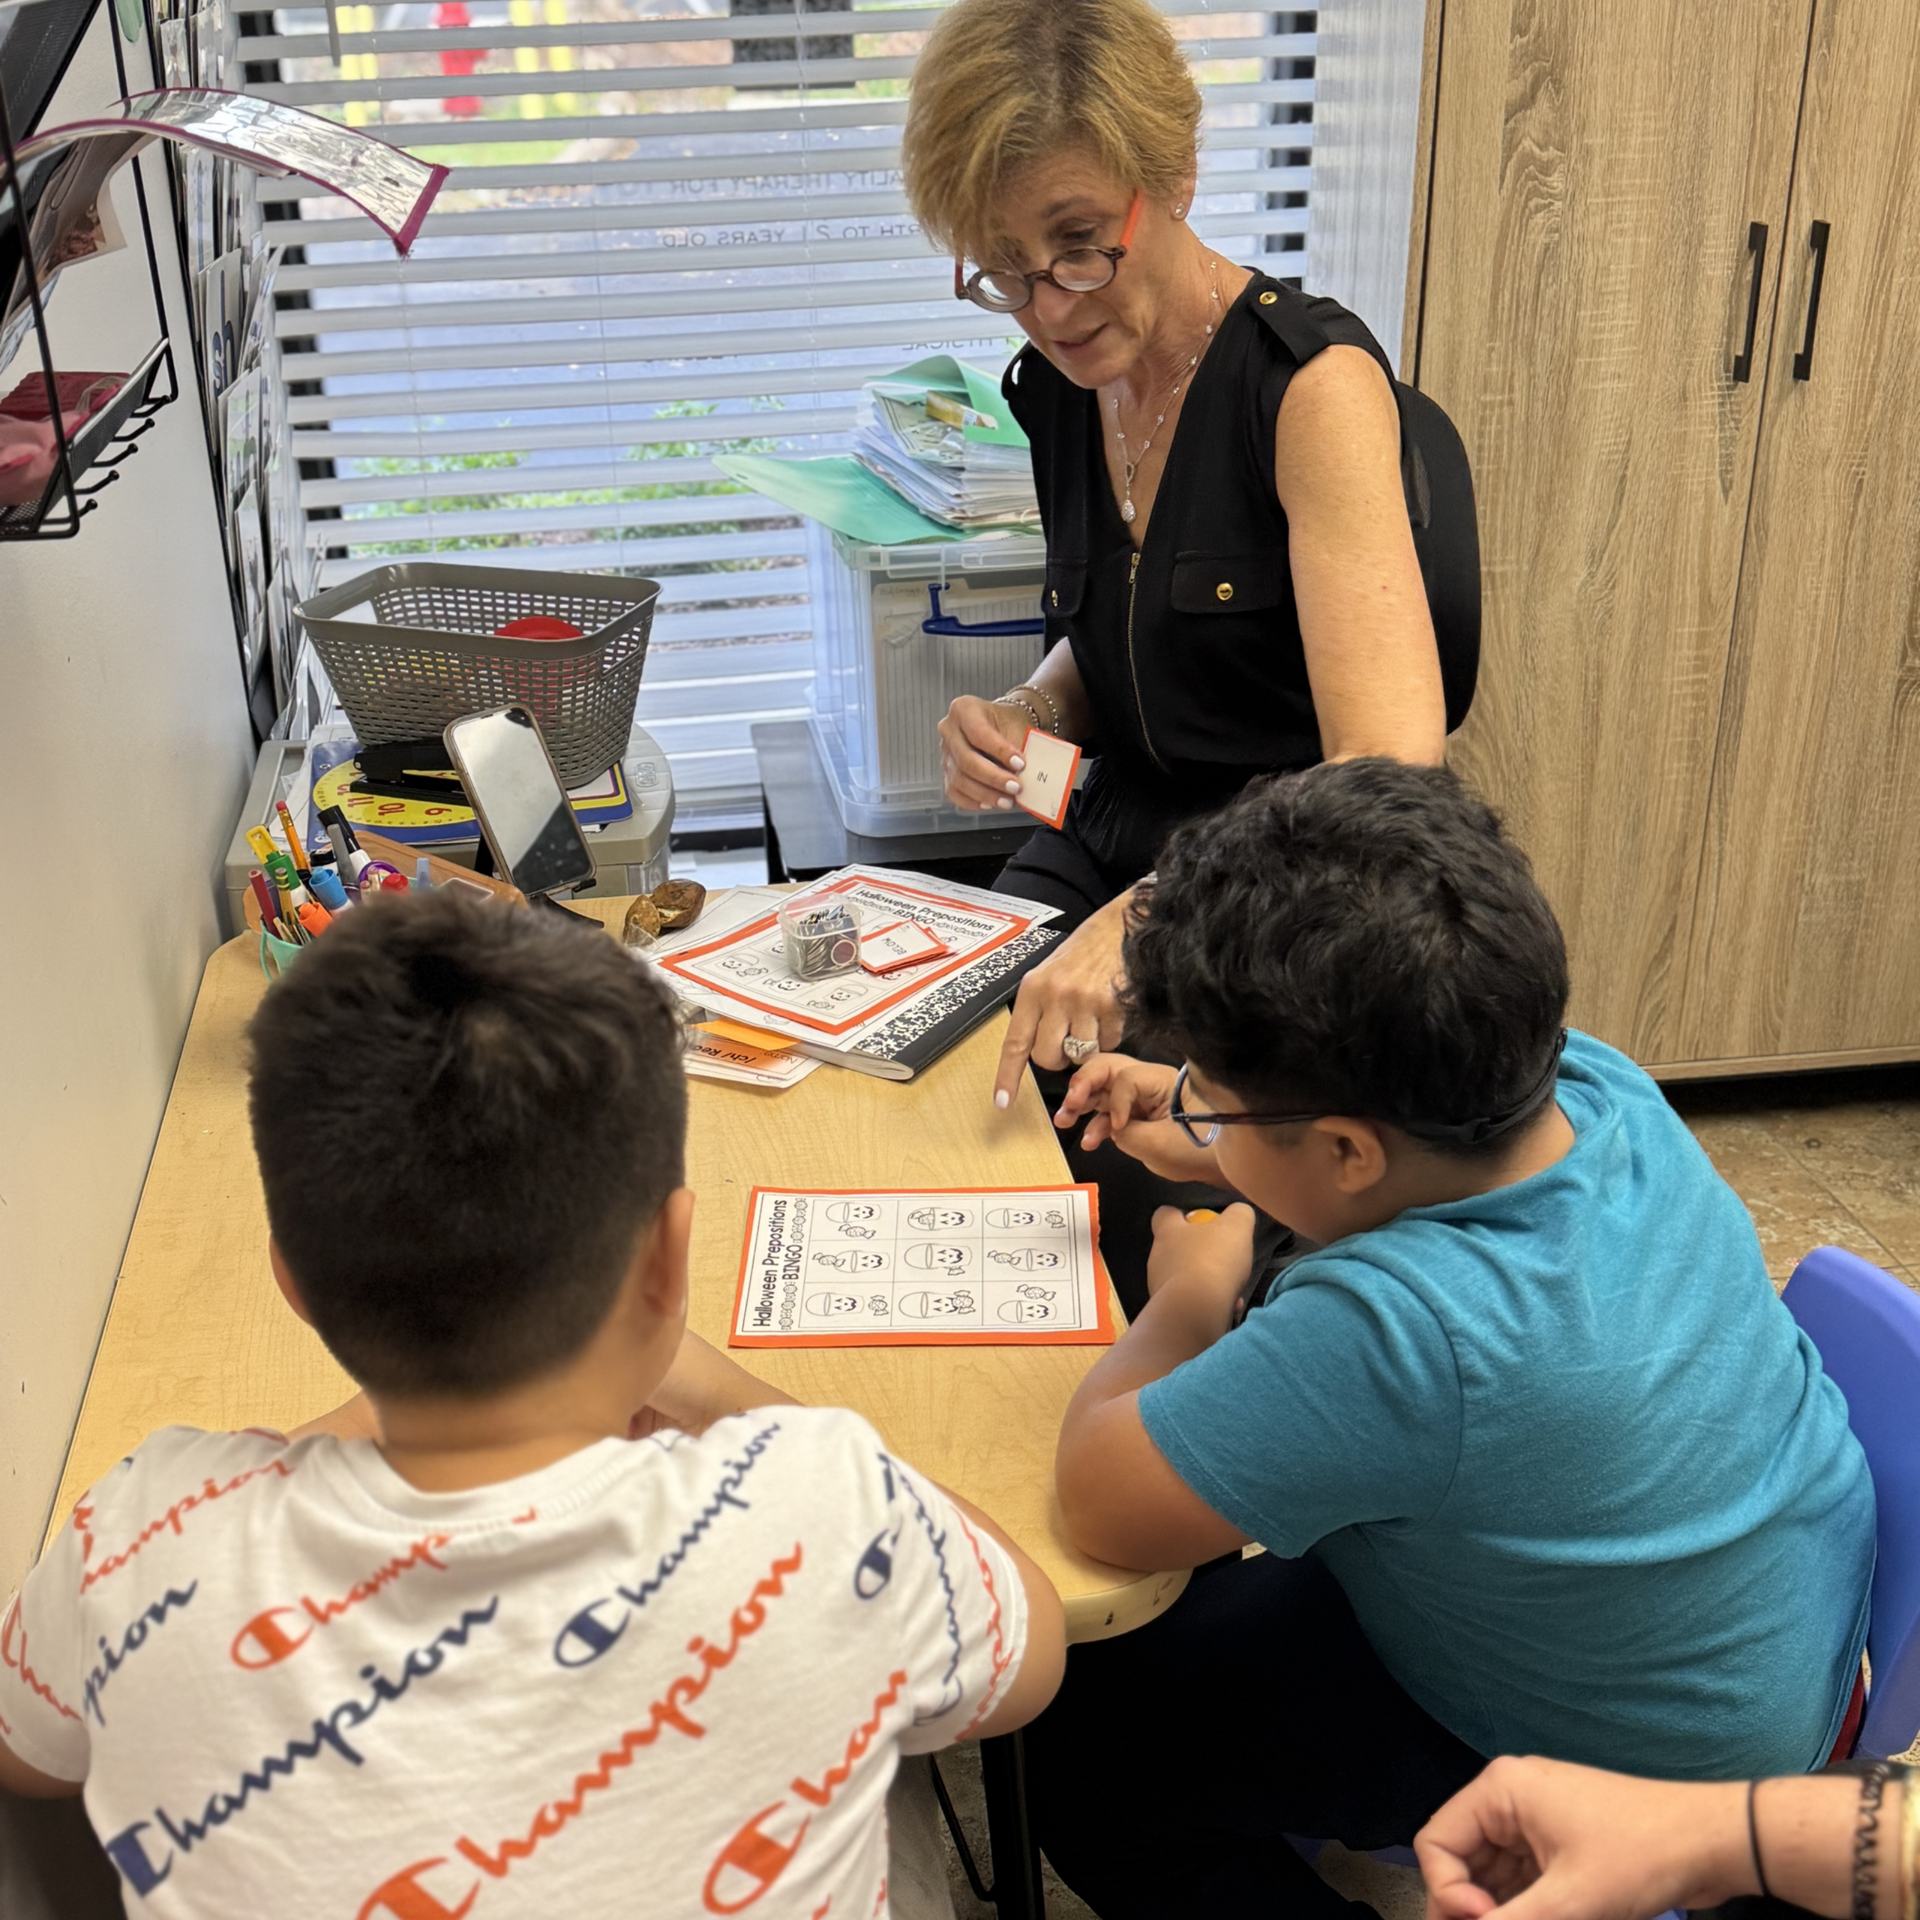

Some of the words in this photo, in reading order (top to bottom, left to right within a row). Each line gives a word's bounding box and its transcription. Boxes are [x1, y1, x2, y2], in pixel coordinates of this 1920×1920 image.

[1036, 770, 1048, 784] IN
[377, 802, 406, 818] 10
[423, 807, 453, 817] 9
[855, 888, 918, 912] Halloween
[917, 906, 995, 932] Prepositions
[892, 908, 936, 926] BINGO
[762, 1199, 788, 1267] Prepositions
[782, 1244, 804, 1281] BINGO
[753, 1268, 778, 1328] Halloween
[553, 1421, 782, 1669] Champion
[355, 1540, 804, 1920] Champion
